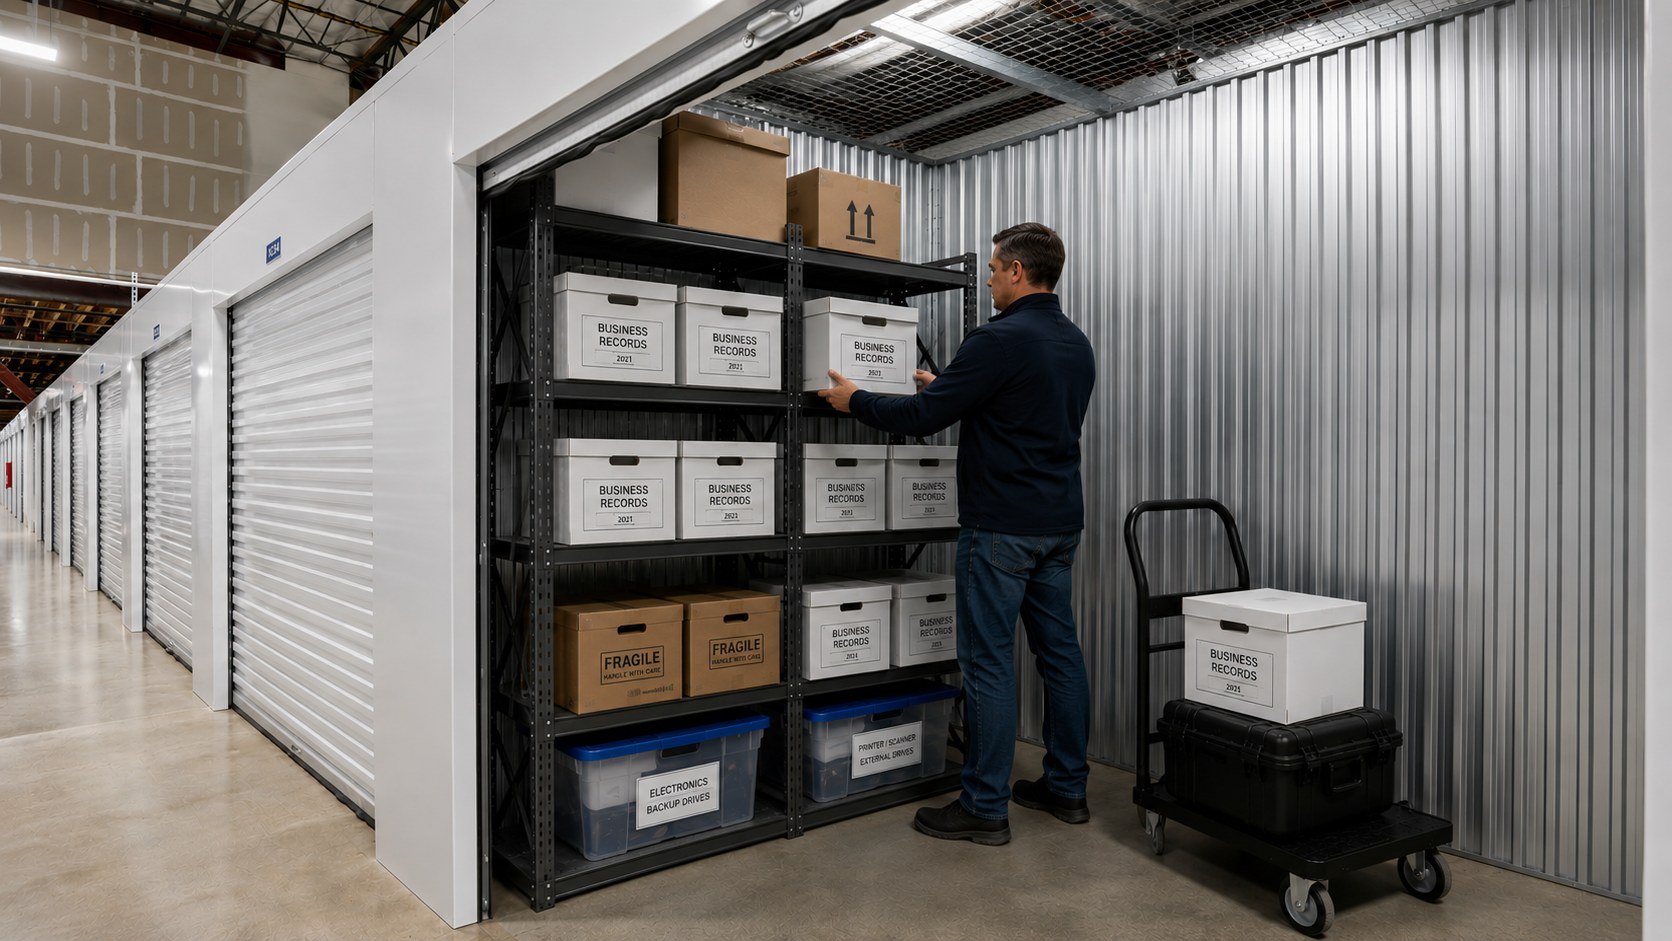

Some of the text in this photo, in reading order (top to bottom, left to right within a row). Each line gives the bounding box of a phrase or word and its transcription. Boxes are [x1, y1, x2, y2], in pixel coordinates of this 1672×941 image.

[598, 323, 648, 336] BUSINESS
[600, 336, 648, 349] RECORDS
[712, 333, 757, 345] BUSINESS
[714, 346, 756, 357] RECORDS
[854, 341, 894, 353] BUSINESS
[855, 353, 894, 364] RECORDS
[600, 485, 648, 495] BUSINESS
[709, 484, 752, 493] BUSINESS
[828, 483, 865, 492] BUSINESS
[912, 482, 946, 490] BUSINESS
[710, 496, 751, 505] RECORDS
[828, 494, 865, 503] RECORDS
[913, 493, 945, 501] RECORDS
[600, 498, 648, 508] RECORDS
[920, 616, 953, 627] BUSINESS
[832, 626, 870, 638] BUSINESS
[920, 626, 952, 637] RECORDS
[712, 638, 760, 656] FRAGILE
[834, 637, 869, 648] RECORDS
[604, 651, 660, 670] FRAGILE
[1210, 648, 1258, 667] BUSINESS
[1212, 662, 1257, 681] RECORDS
[858, 740, 884, 752] PRINTER
[889, 734, 916, 746] SCANNER
[860, 747, 914, 766] EXTERNAL DRIVES
[650, 777, 708, 798] ELECTRONICS
[646, 792, 710, 815] BACKUP DRIVES
